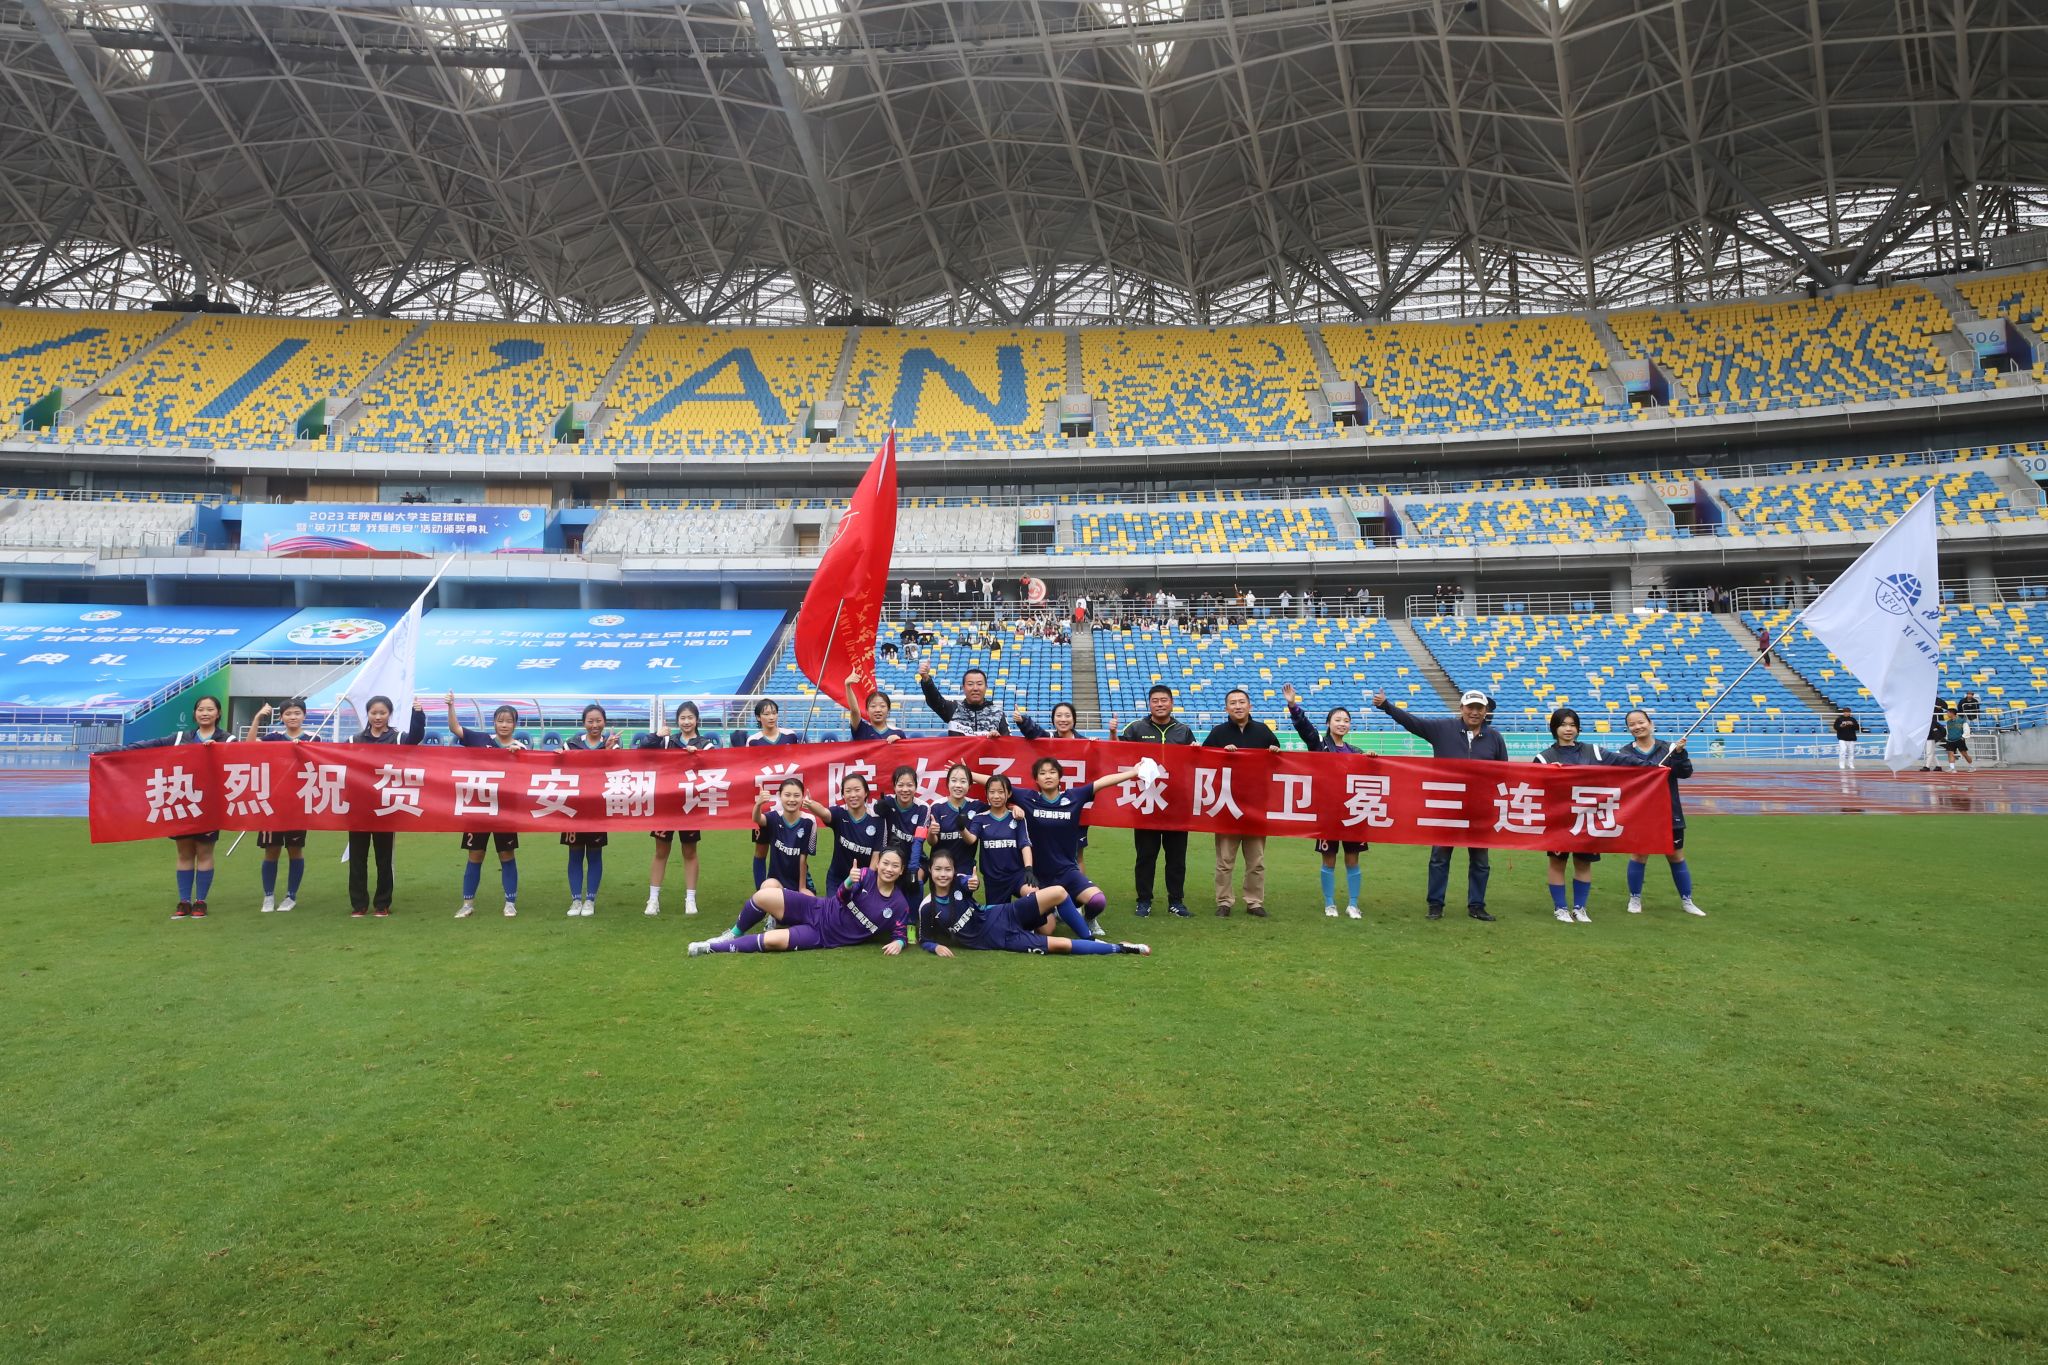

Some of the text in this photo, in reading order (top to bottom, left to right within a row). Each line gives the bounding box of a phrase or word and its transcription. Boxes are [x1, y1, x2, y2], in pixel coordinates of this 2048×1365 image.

[1656, 484, 1688, 497] 305
[1352, 499, 1379, 510] 304
[1024, 508, 1050, 519] 303
[1879, 591, 1902, 612] XFU
[451, 655, 683, 670] 颁奖典礼
[466, 833, 473, 847] 2
[755, 829, 761, 840] 9
[1318, 839, 1329, 851] 16
